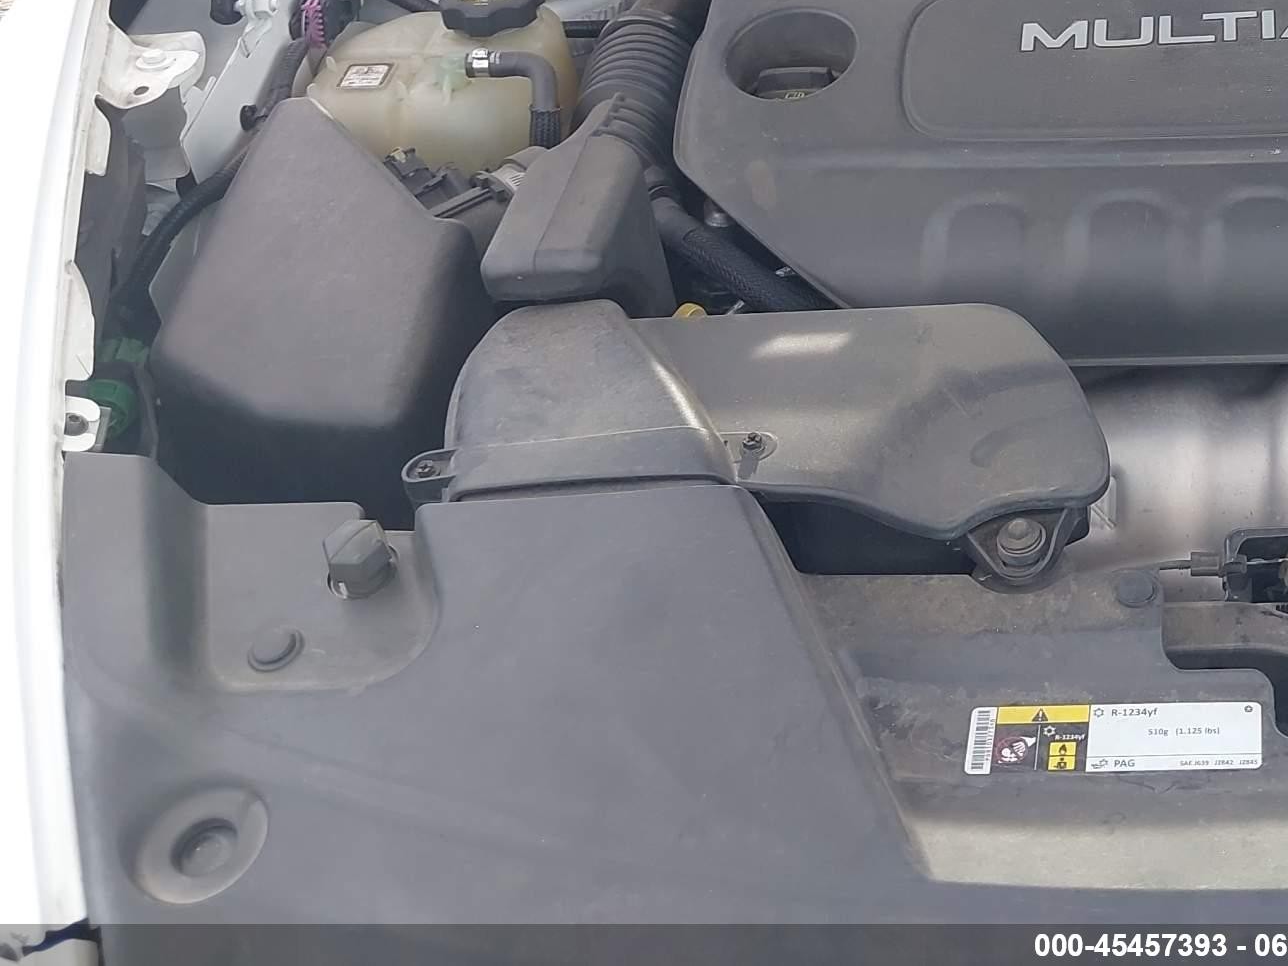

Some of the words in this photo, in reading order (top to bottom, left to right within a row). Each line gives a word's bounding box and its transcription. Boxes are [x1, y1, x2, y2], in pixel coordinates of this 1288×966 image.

[1111, 707, 1158, 718] R-1234yf
[1148, 728, 1168, 737] 510g
[1175, 727, 1202, 735] (1.125
[1204, 726, 1220, 735] lbs)
[1113, 759, 1136, 768] PAG
